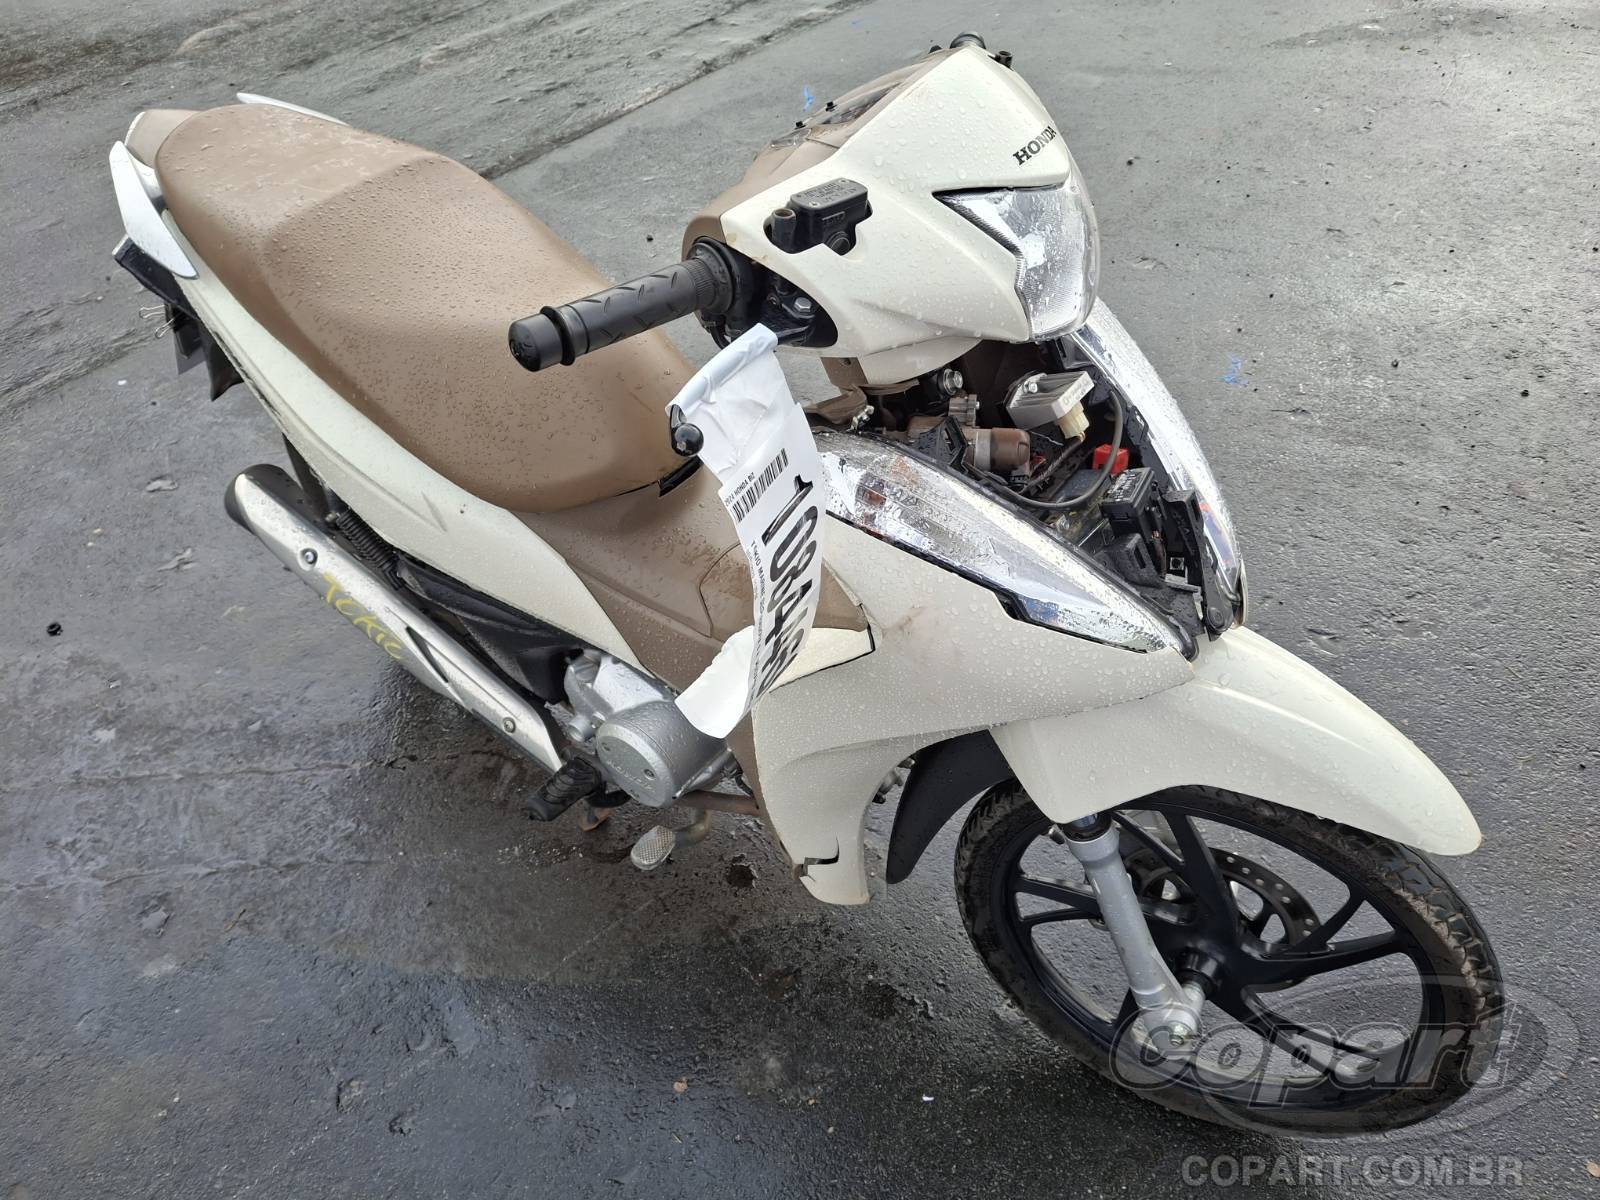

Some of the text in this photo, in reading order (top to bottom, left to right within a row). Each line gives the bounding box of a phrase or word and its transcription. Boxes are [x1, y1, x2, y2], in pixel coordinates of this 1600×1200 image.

[1012, 125, 1057, 166] HONDA
[733, 479, 749, 496] HONDA
[757, 473, 818, 698] 108446
